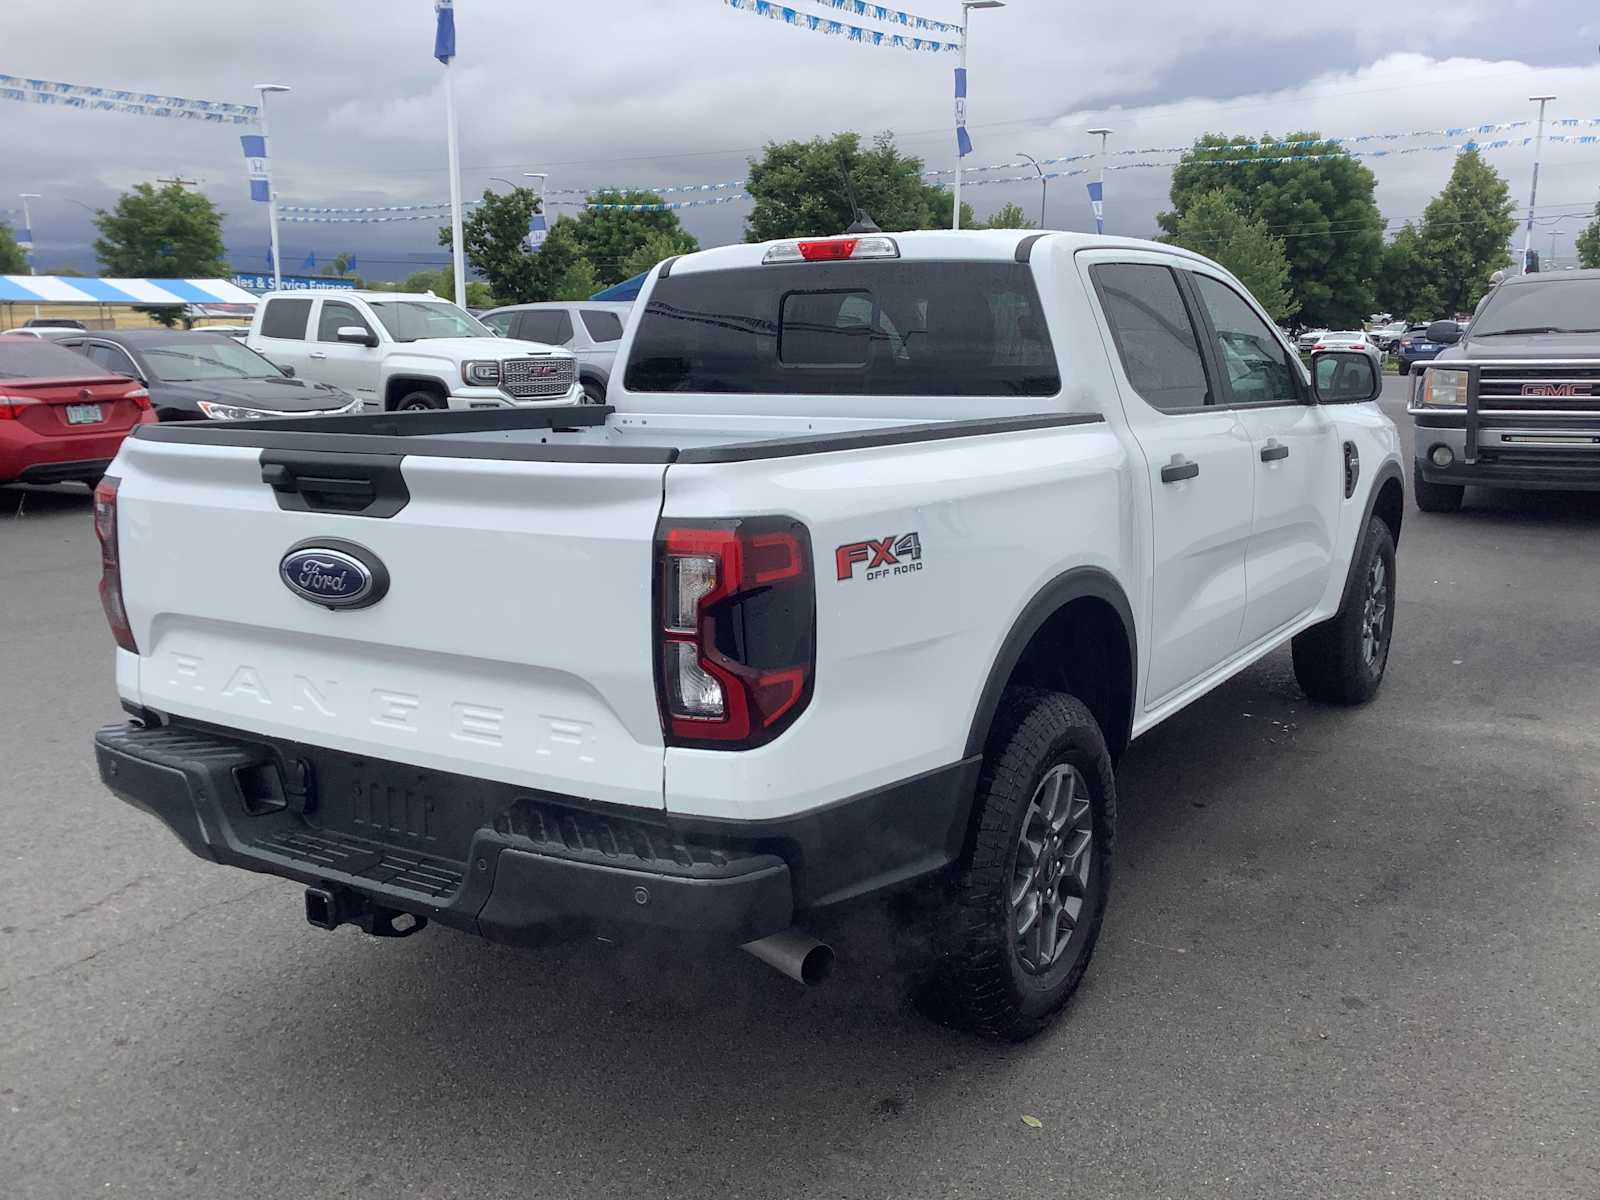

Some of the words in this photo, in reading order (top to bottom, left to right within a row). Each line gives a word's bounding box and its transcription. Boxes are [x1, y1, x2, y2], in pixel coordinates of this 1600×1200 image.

[256, 277, 265, 288] &
[268, 278, 307, 290] Srvice
[1521, 383, 1593, 397] GMC
[835, 531, 922, 581] FX4
[299, 559, 348, 592] Ford
[866, 568, 890, 581] OFF
[894, 562, 923, 576] ROAD
[168, 651, 597, 764] RANGER
